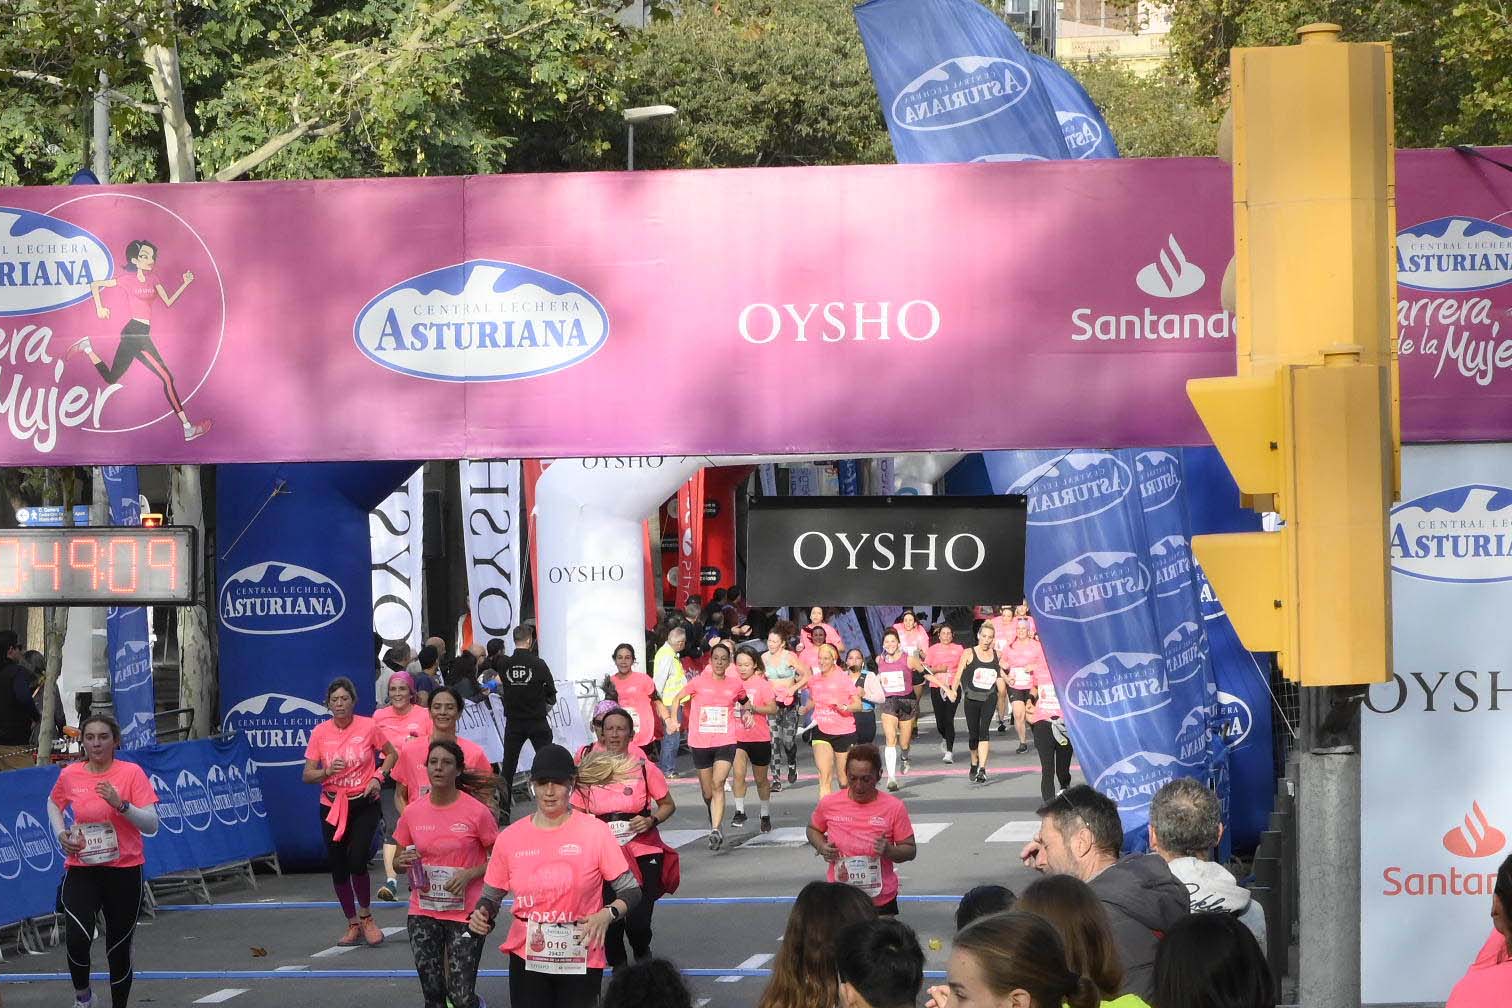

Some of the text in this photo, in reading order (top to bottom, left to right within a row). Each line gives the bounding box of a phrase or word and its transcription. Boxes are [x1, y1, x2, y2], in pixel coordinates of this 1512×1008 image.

[17, 244, 88, 255] LECHERA
[1411, 241, 1512, 251] CENTRAL LECHER
[414, 300, 581, 316] CENTRAL LECHERA
[1397, 298, 1492, 326] arrera
[374, 307, 588, 351] ASTURIANA
[739, 300, 941, 344] OYSHO
[1071, 308, 1237, 341] Santand
[1420, 321, 1512, 386] la Muje
[1418, 520, 1482, 530] CENTRAL
[469, 460, 512, 636] OYSH
[793, 531, 986, 572] OYSHO
[1391, 522, 1512, 558] ASTURI
[369, 484, 413, 647] OYS
[549, 564, 624, 584] OYSHO
[237, 586, 331, 595] CENTRAL LECHERA
[224, 591, 336, 617] ASTURIANA
[513, 669, 526, 679] BP
[1363, 670, 1512, 714] OYSH
[238, 718, 278, 726] CENTRAL
[517, 896, 534, 908] TU
[547, 941, 567, 949] 016
